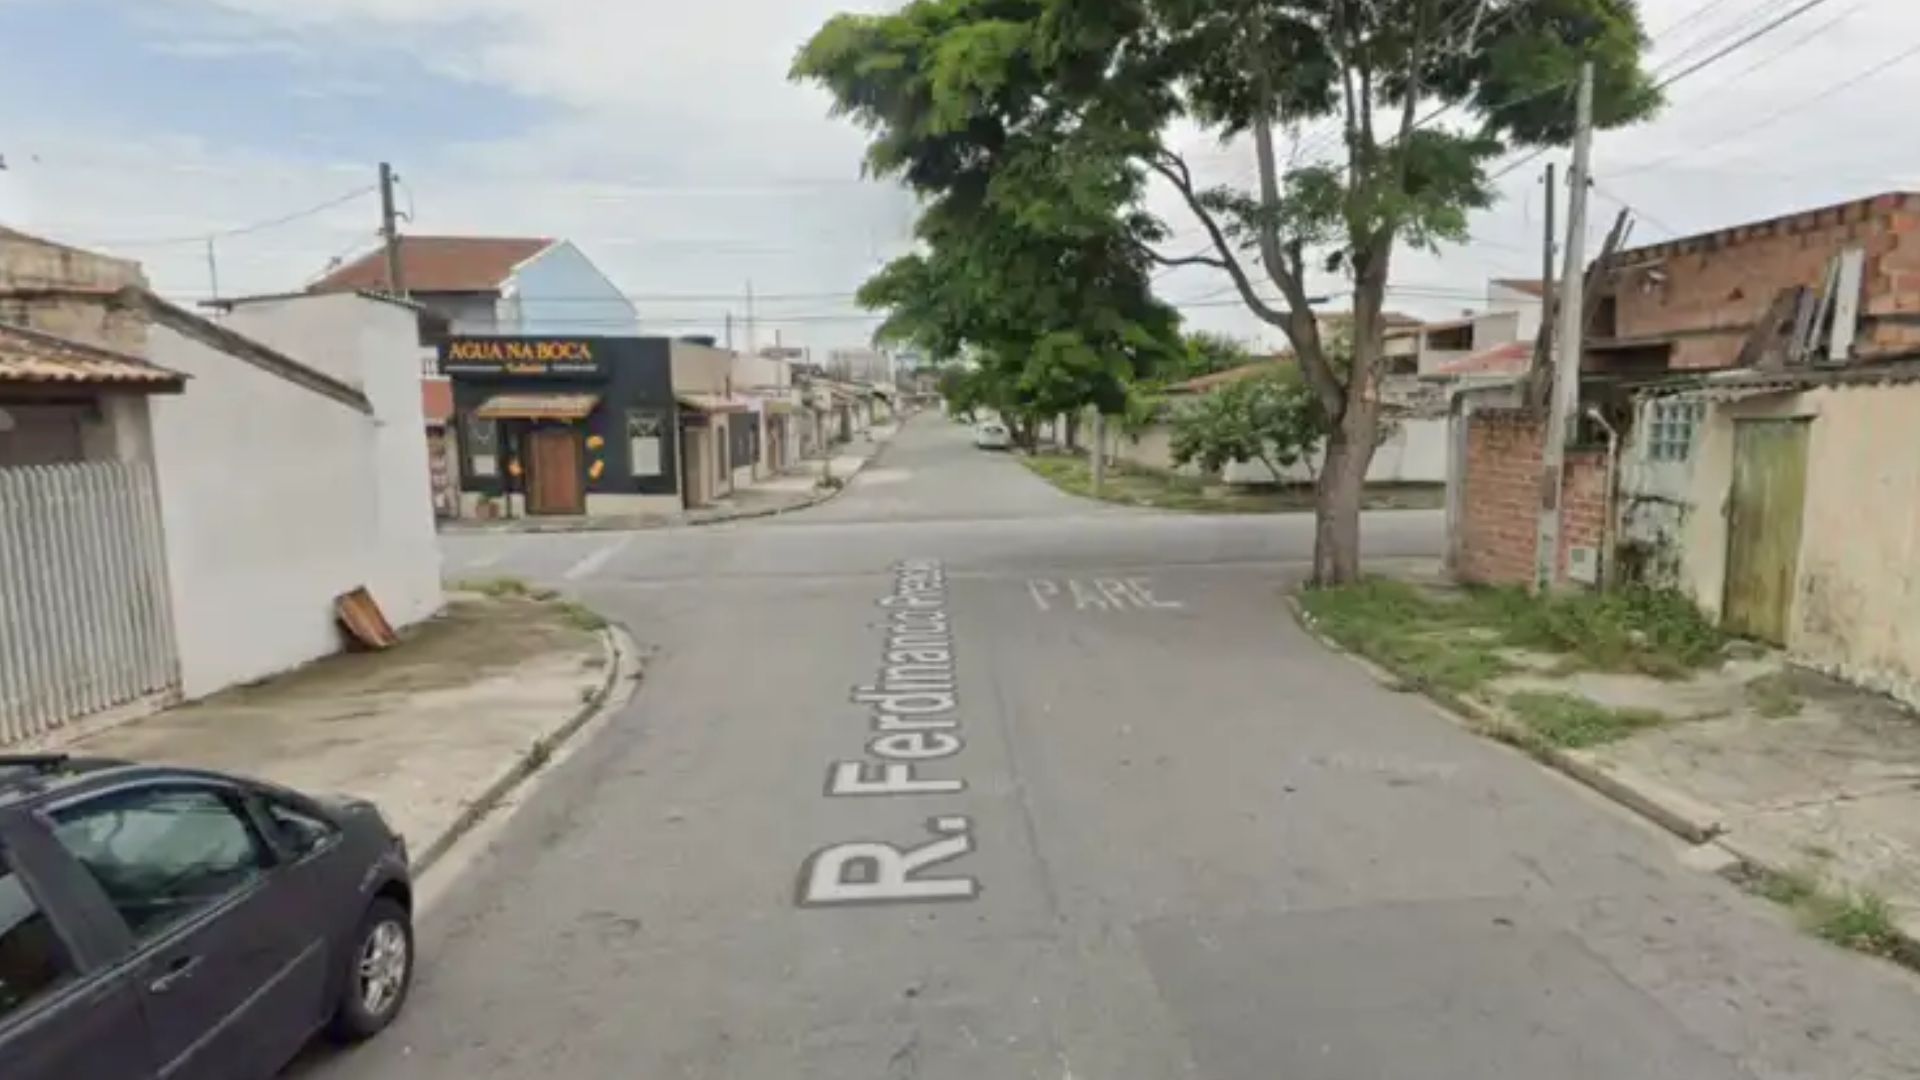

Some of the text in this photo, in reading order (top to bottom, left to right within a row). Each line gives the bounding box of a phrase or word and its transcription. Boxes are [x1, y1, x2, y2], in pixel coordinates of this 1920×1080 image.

[507, 341, 535, 360] NA
[537, 341, 592, 360] BOCA
[1027, 578, 1183, 611] PARE
